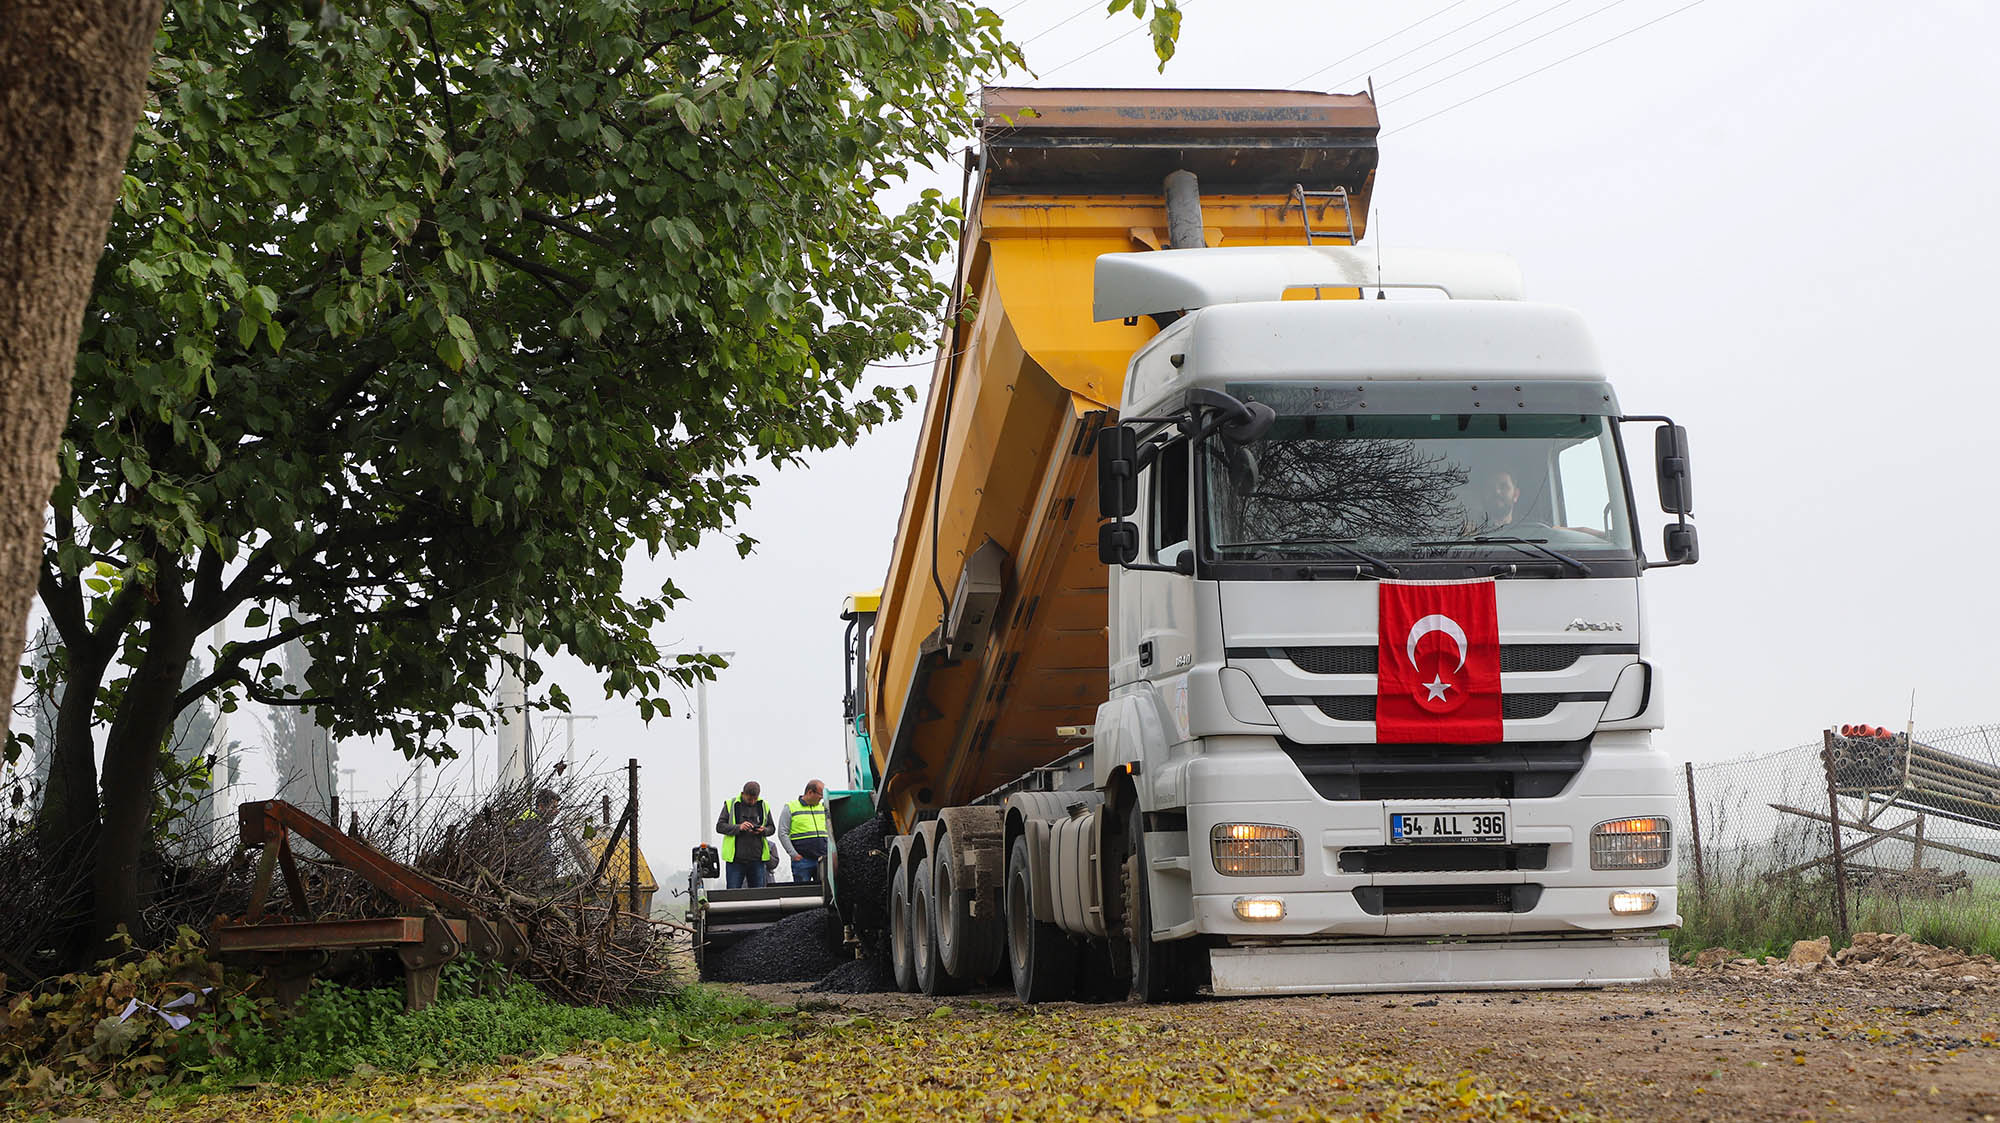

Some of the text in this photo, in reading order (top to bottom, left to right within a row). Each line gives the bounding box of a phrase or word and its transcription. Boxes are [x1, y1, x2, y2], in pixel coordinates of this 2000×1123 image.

[1402, 816, 1502, 835] 54 ALL 396
